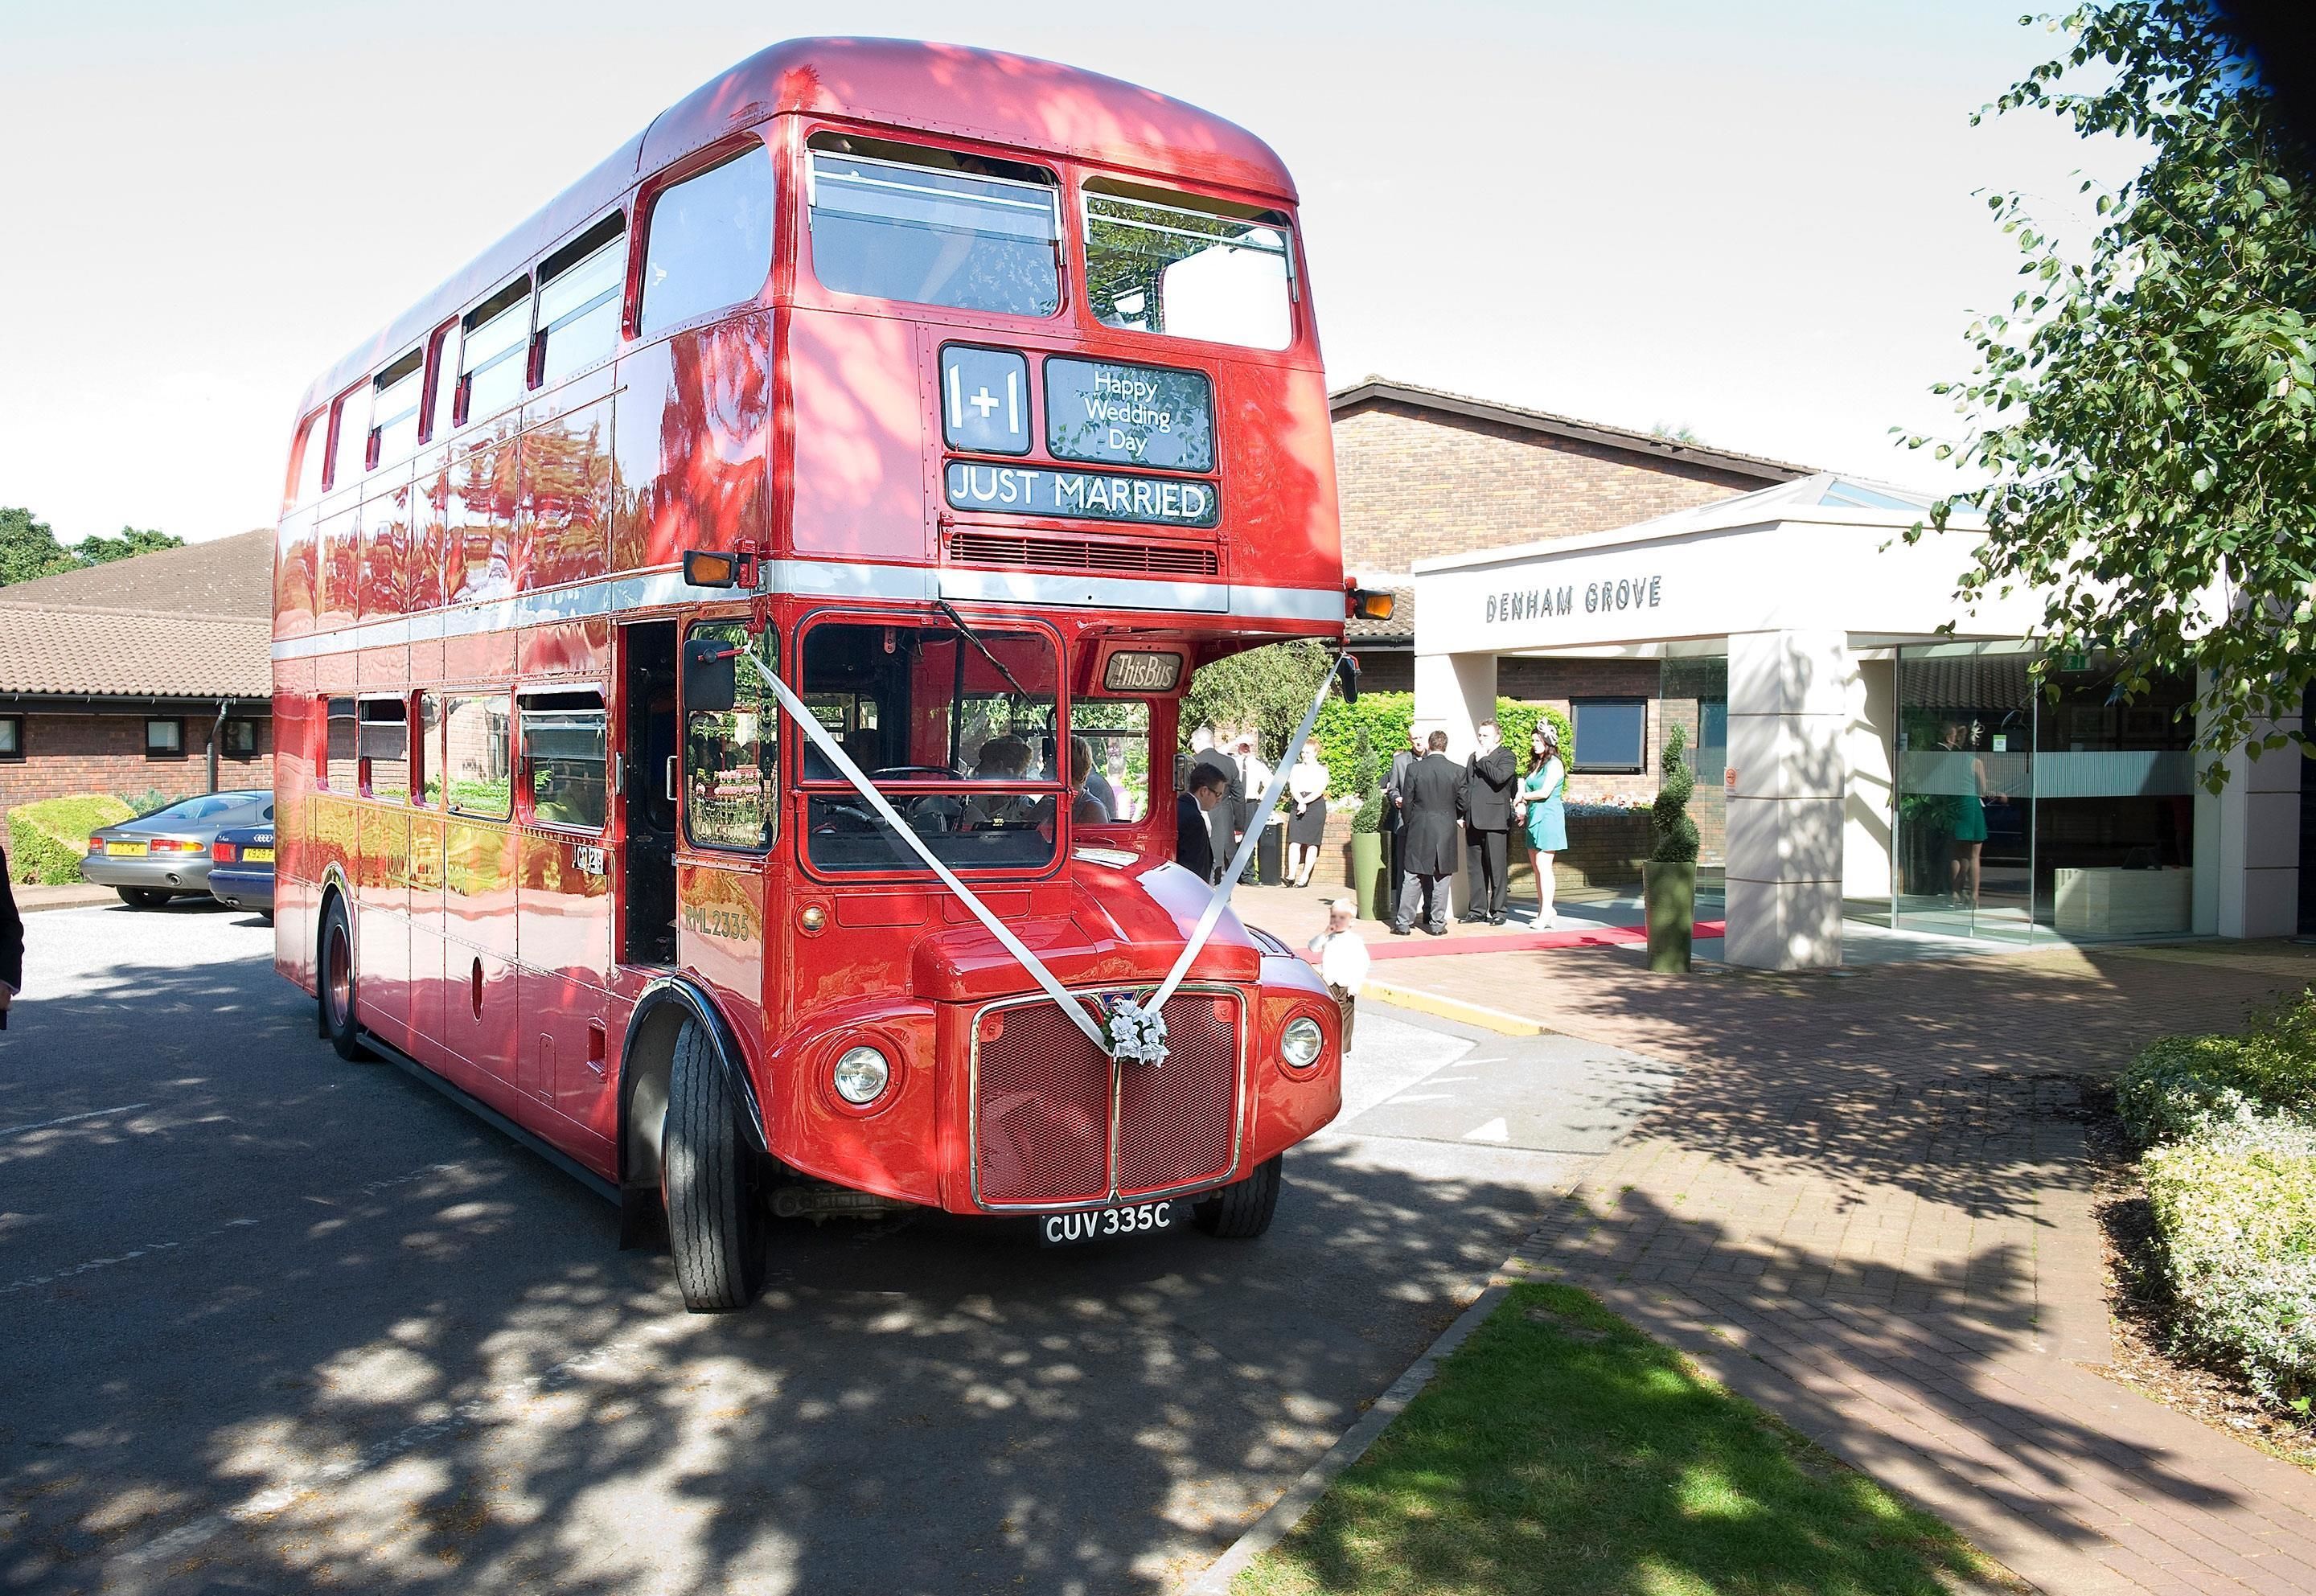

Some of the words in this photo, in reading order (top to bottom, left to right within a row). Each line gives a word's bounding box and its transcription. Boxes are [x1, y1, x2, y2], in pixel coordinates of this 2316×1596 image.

[1094, 370, 1160, 404] Happy
[1083, 397, 1172, 434] Wedding
[1108, 428, 1149, 457] Day
[951, 464, 1041, 505] JUST
[1054, 473, 1206, 519] MARRIED
[1485, 585, 1574, 624] DENHAM
[1584, 575, 1662, 613] GROVE
[1045, 1211, 1099, 1243] CUV
[1102, 1202, 1171, 1235] 335C
